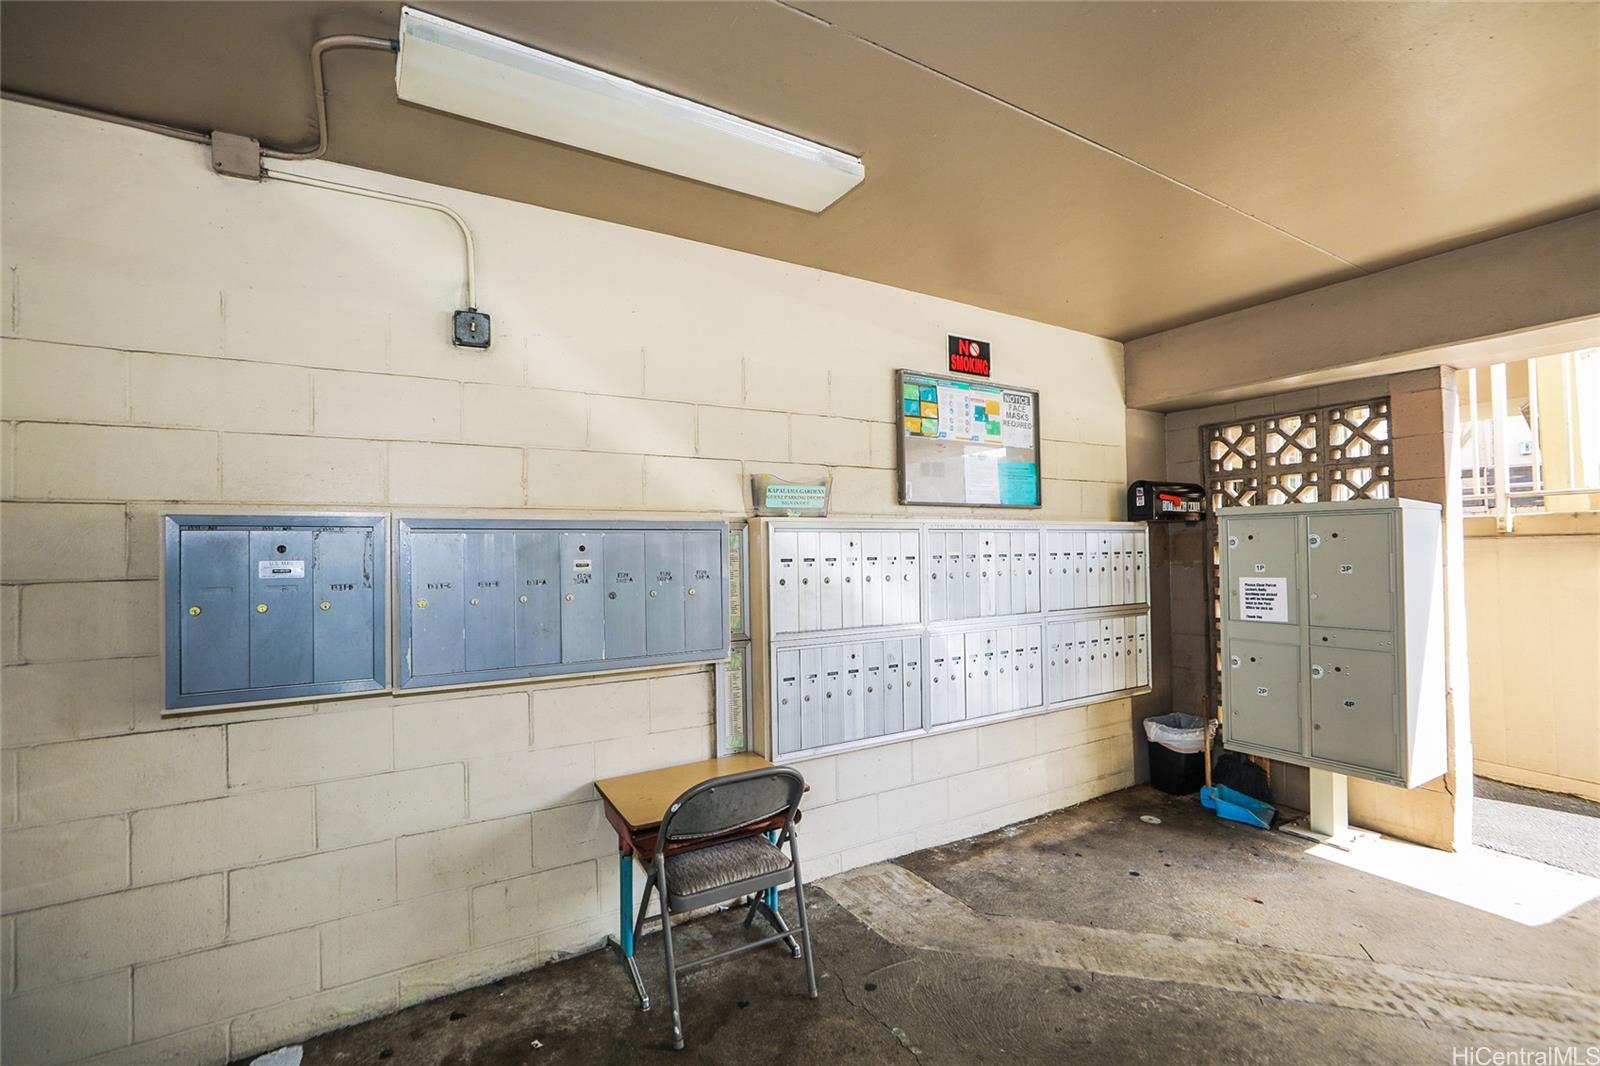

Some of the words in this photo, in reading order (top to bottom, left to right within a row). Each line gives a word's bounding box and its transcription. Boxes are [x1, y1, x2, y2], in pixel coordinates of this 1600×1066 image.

[958, 339, 980, 357] NO
[951, 354, 988, 375] SMOKING
[1004, 394, 1029, 405] NOTICE
[1008, 404, 1026, 412] FACE
[1006, 412, 1030, 421] MASKS
[1003, 420, 1032, 430] REQUIRED
